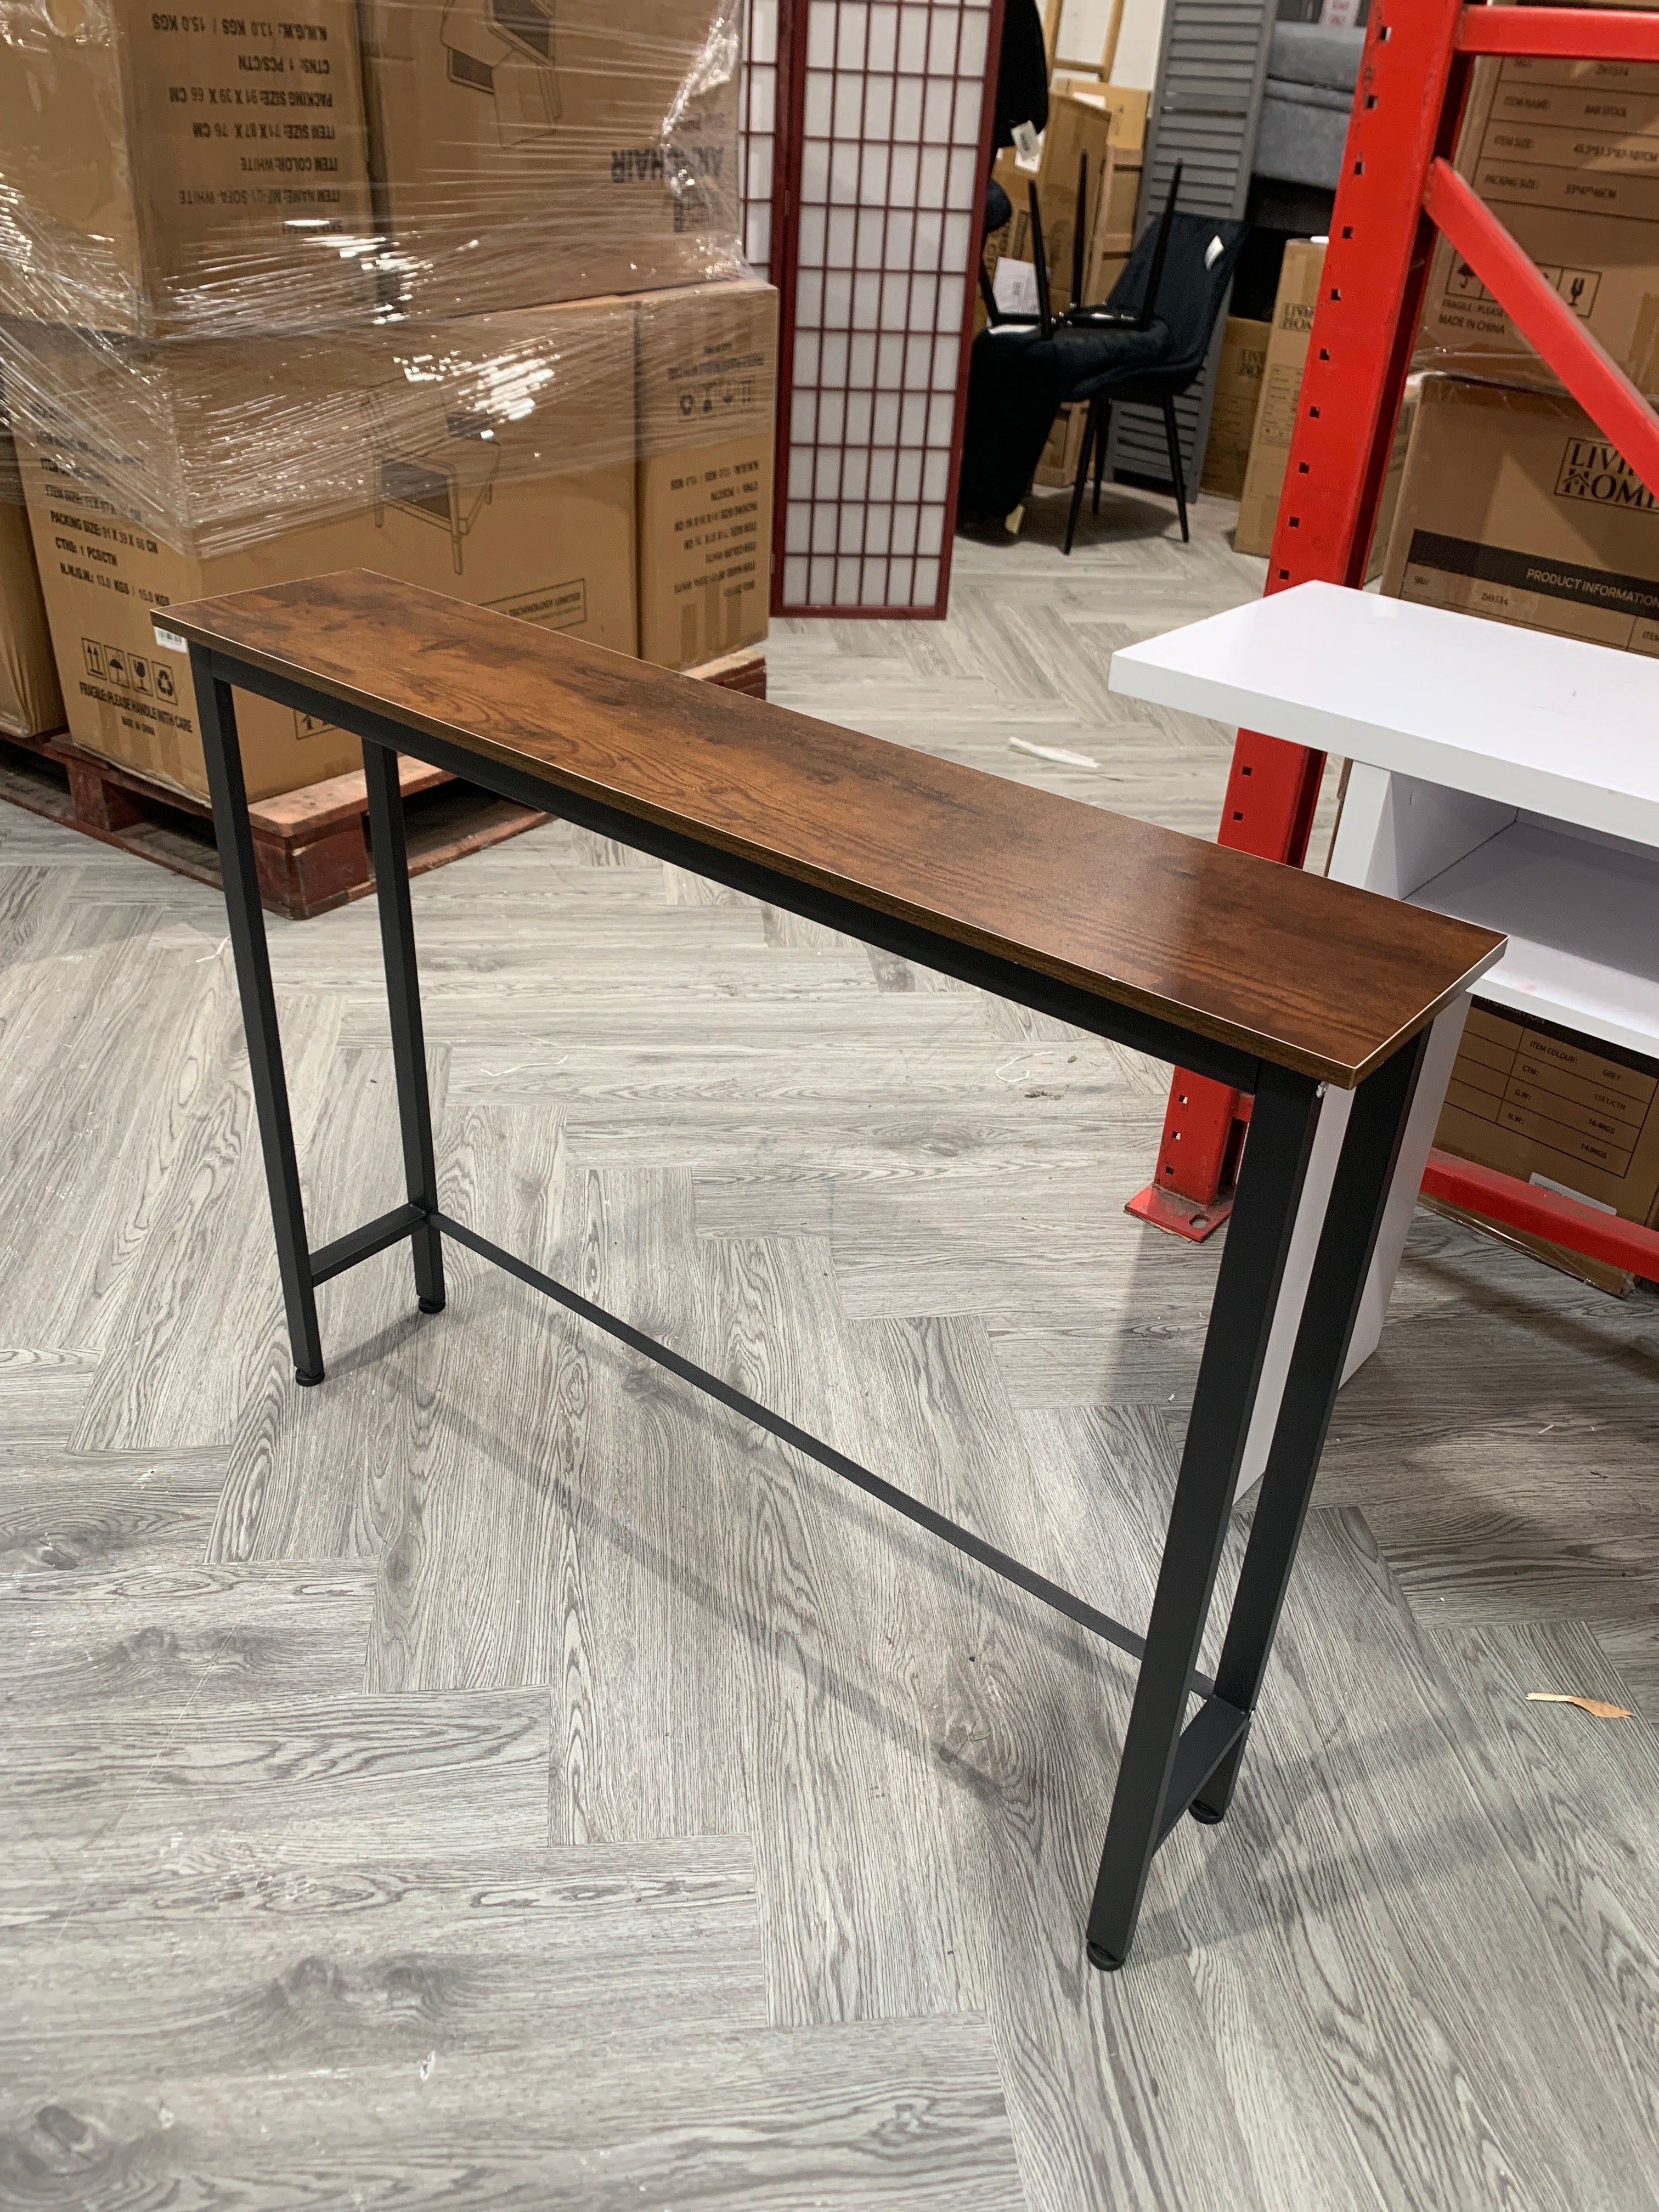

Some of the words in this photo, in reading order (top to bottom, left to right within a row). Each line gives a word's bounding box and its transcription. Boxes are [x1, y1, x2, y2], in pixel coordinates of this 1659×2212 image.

[152, 14, 177, 30] KGS
[182, 16, 206, 32] 15.0
[222, 19, 245, 35] KGS
[251, 21, 273, 37] 13.0
[1526, 568, 1583, 590] PRODUCT
[1530, 1040, 1546, 1052] ITEM
[1602, 1069, 1622, 1081] GREY
